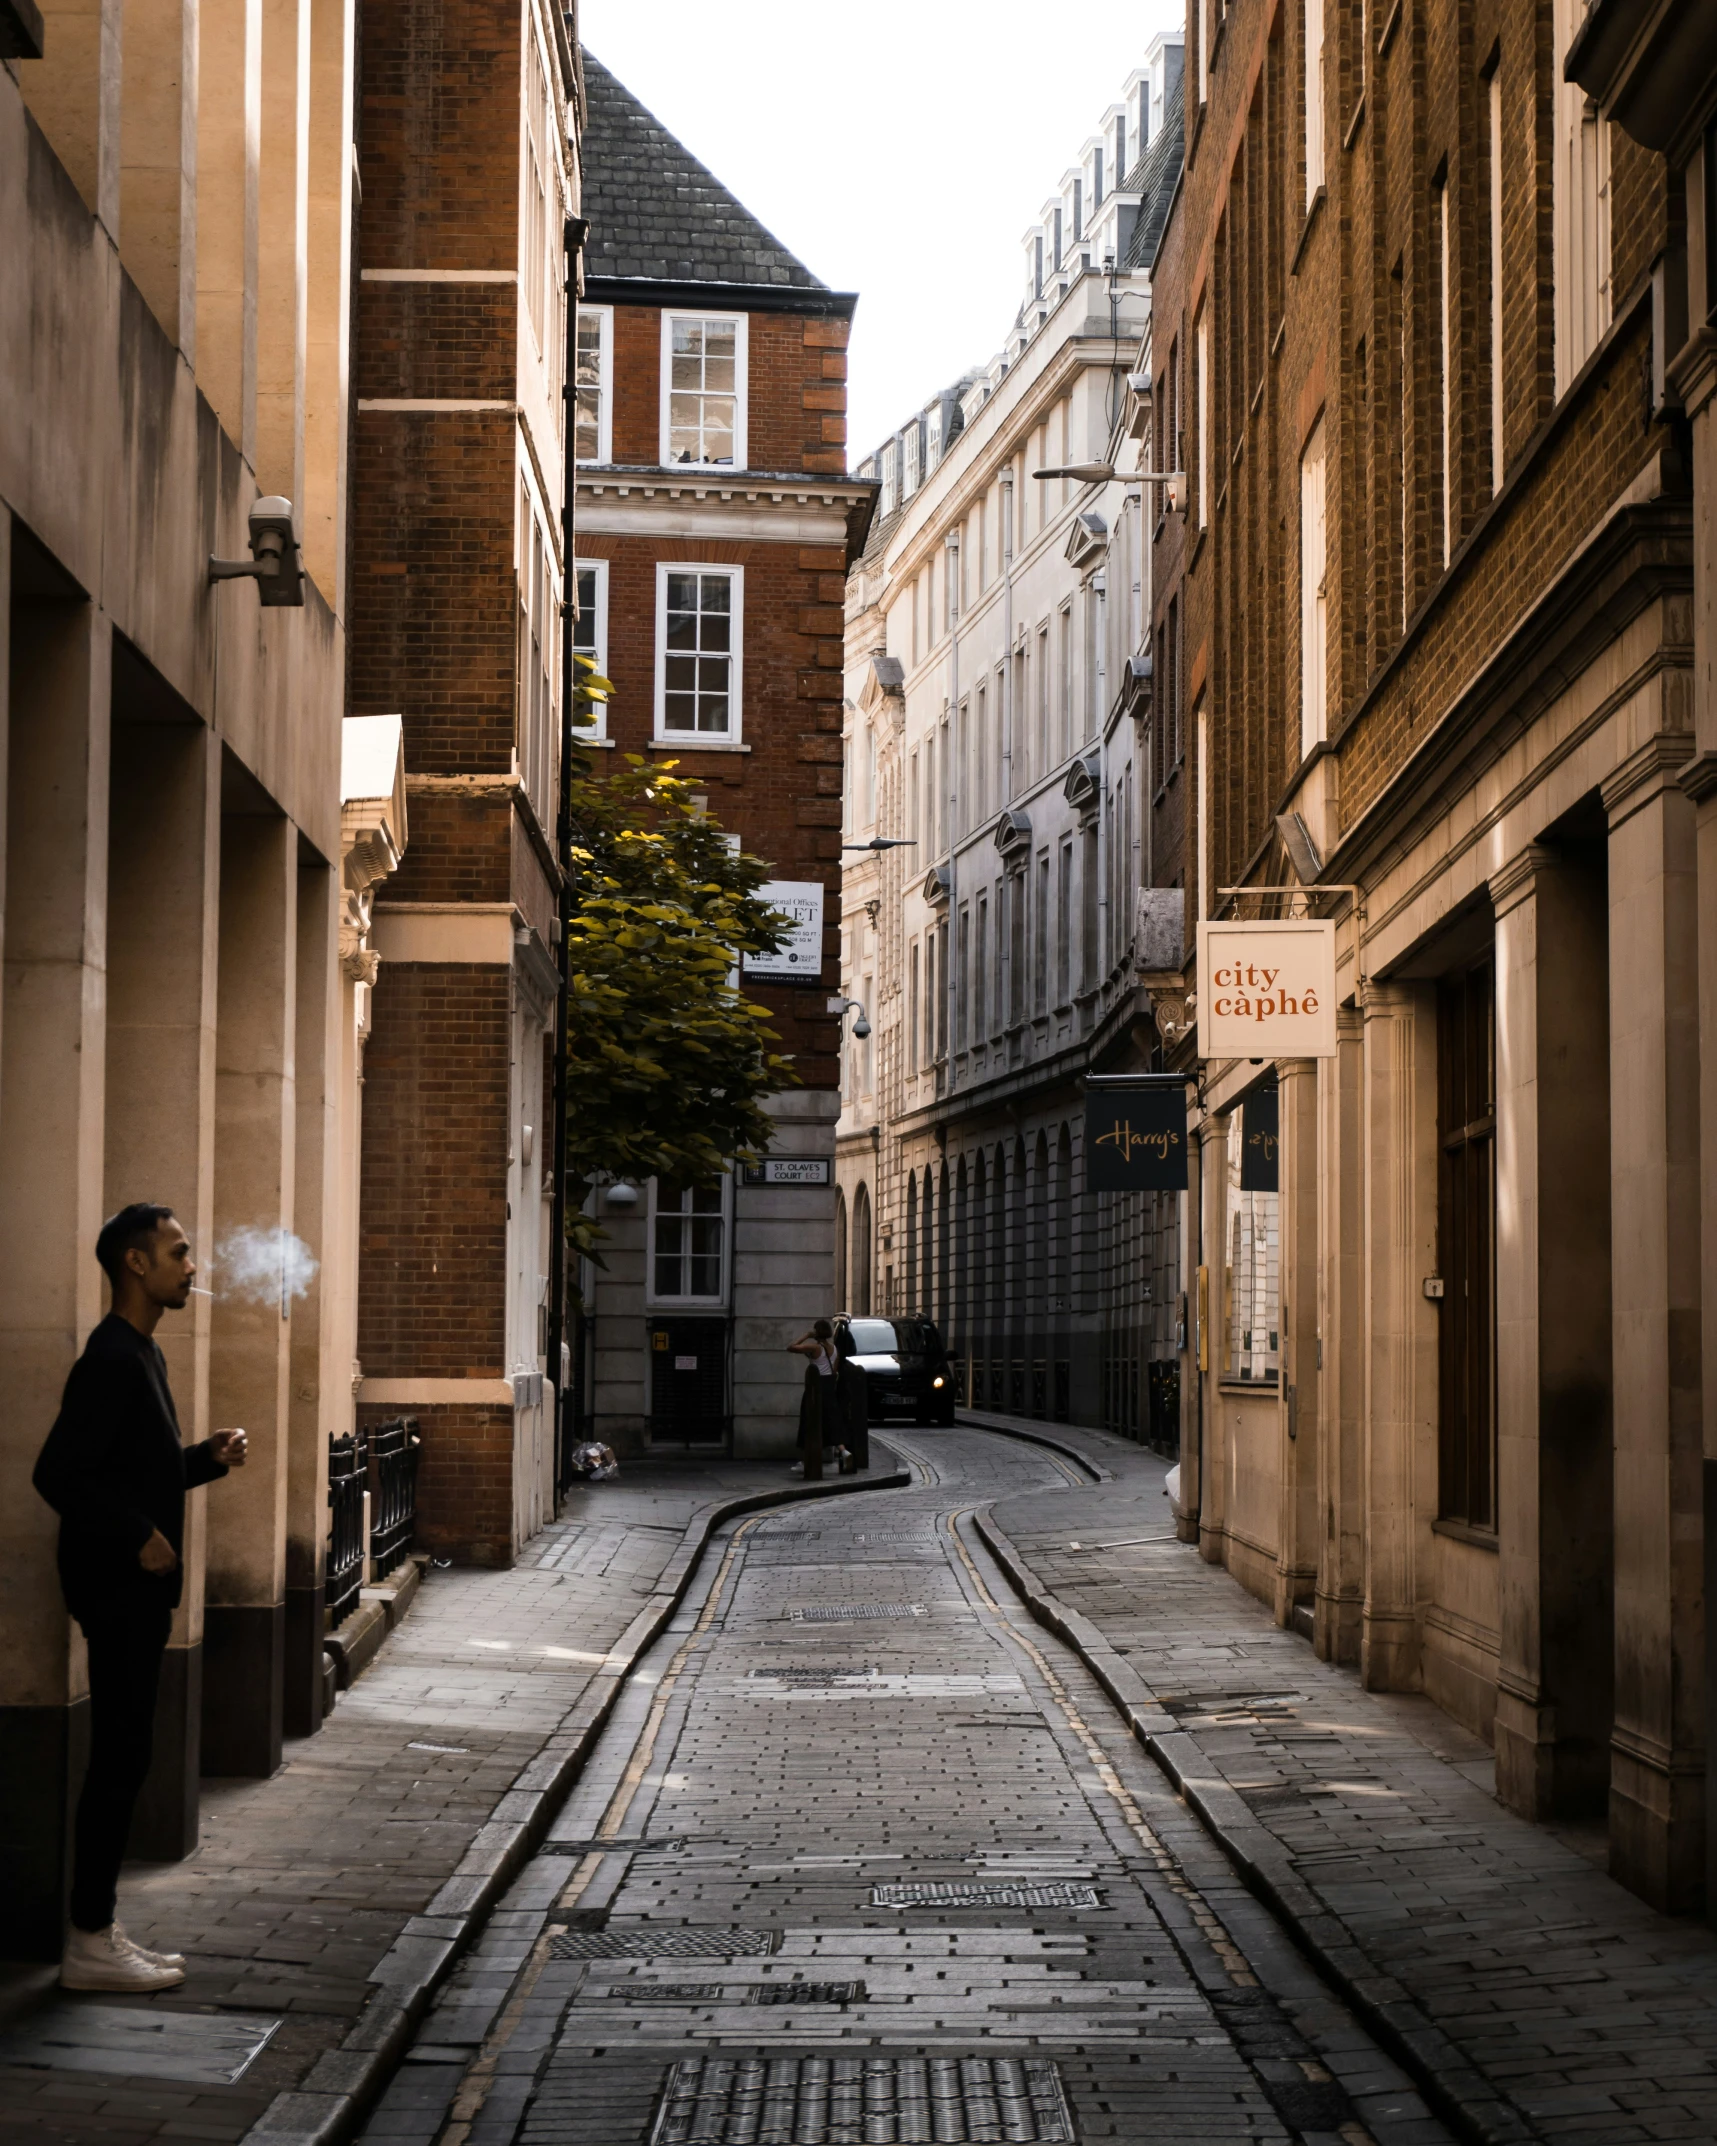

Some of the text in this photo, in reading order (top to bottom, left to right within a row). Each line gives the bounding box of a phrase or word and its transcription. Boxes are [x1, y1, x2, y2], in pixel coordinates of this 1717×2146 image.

[793, 898, 818, 907] Offices
[1214, 961, 1280, 993] city
[1214, 988, 1319, 1022] càphê
[1095, 1119, 1179, 1162] Harry's
[774, 1163, 820, 1171] ST. OLAVE'S
[774, 1172, 820, 1180] COURT EC2
